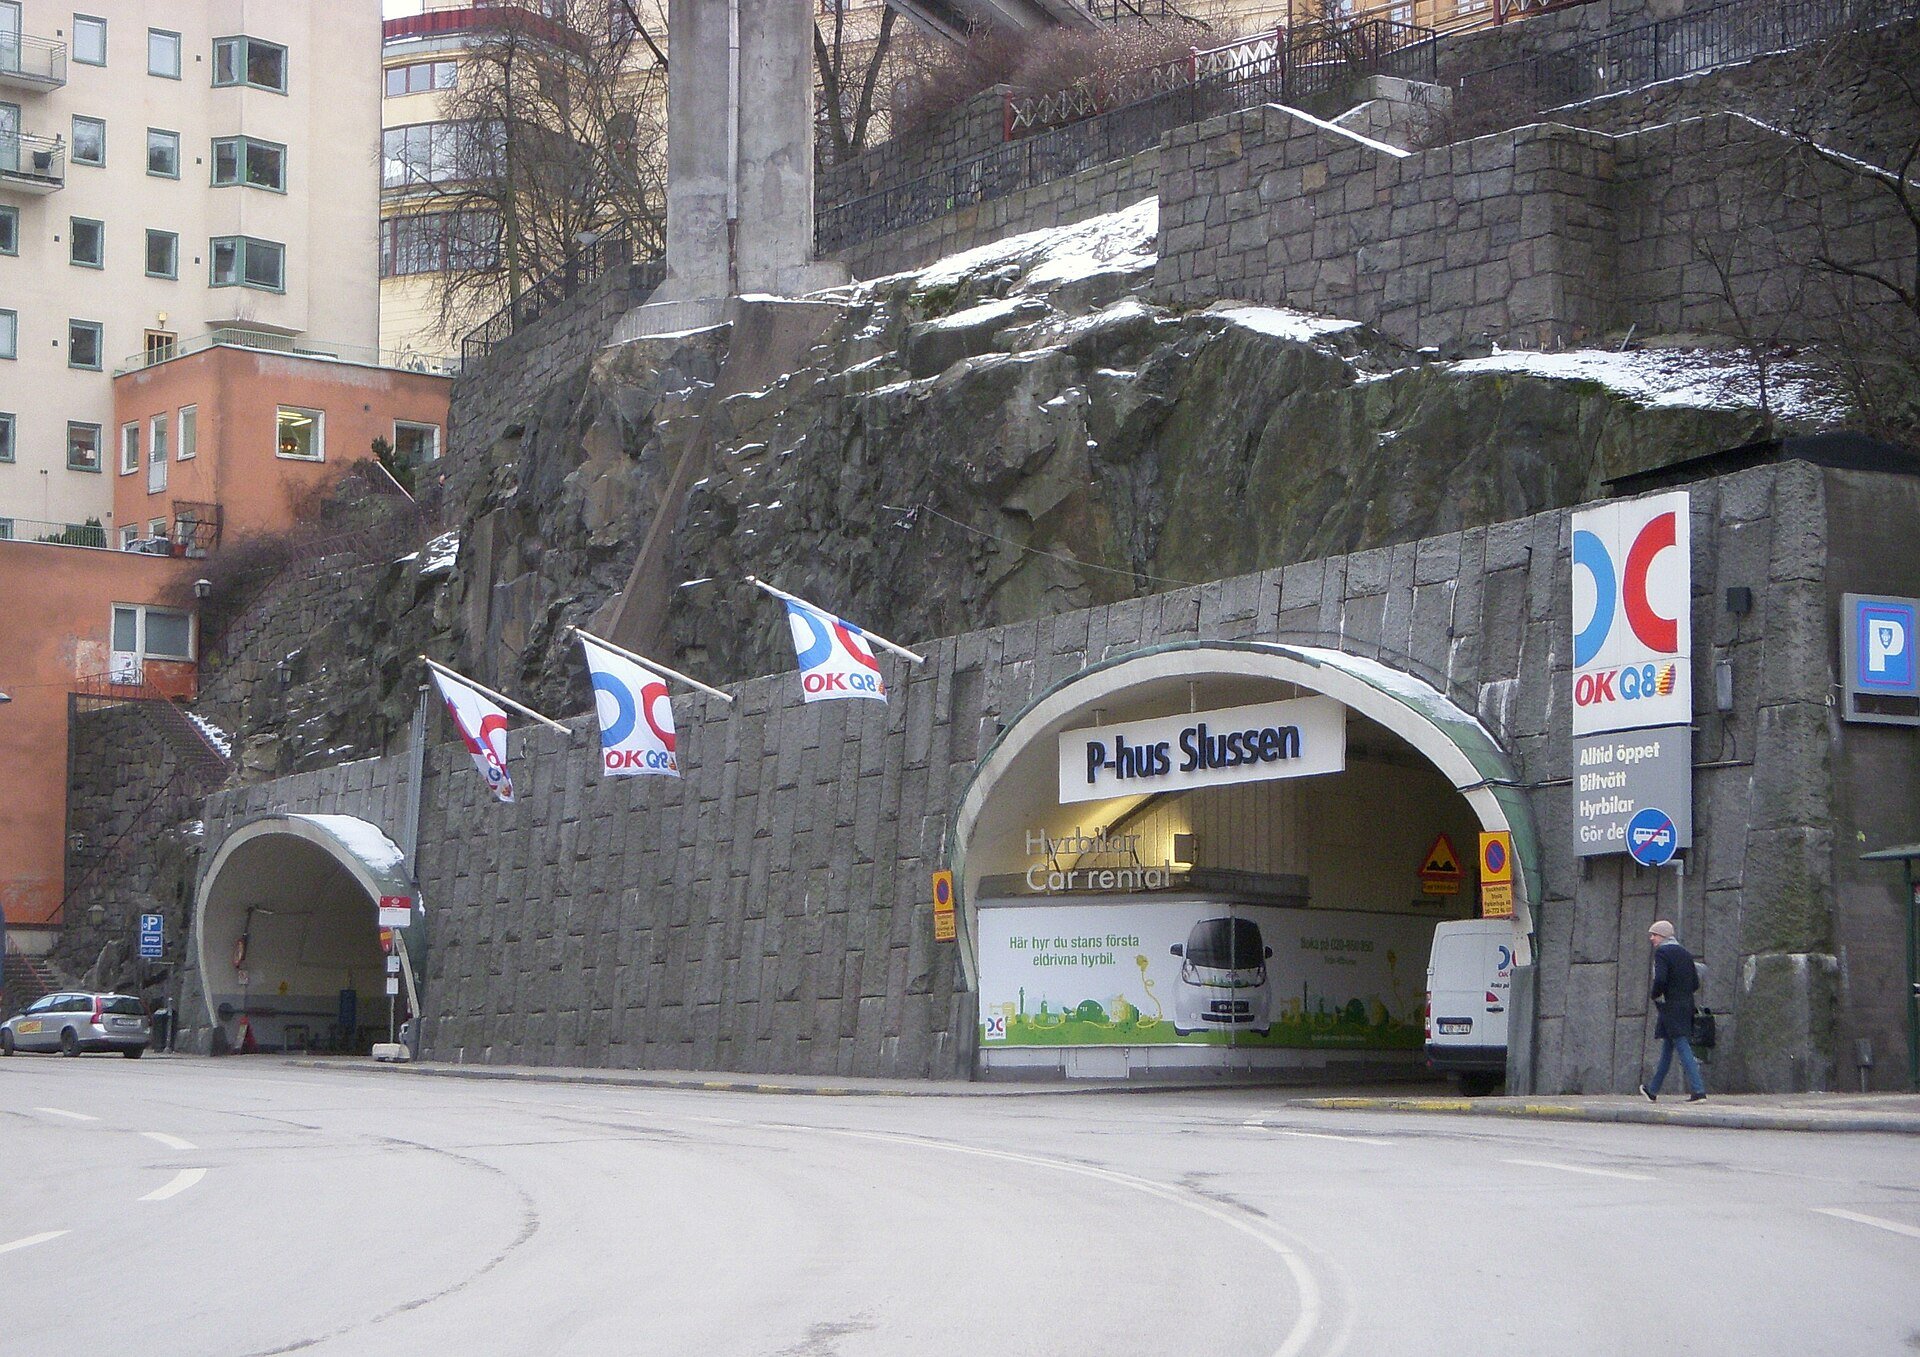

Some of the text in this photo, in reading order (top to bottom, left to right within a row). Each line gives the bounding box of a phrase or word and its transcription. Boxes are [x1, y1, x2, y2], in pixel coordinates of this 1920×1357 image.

[1869, 619, 1904, 671] P
[1087, 723, 1300, 783] P-hus Slussen
[1580, 742, 1660, 766] Alltid öppet
[1580, 771, 1626, 791] Biltvätt
[1580, 796, 1634, 820] Hyrbilar
[1026, 825, 1140, 861] Hyrbilar
[1580, 822, 1627, 842] Gör de
[1026, 858, 1170, 890] Car rental
[147, 916, 158, 930] P
[1009, 934, 1140, 950] Här hyr du stans första
[1033, 952, 1116, 968] eldrivna hyrbil.
